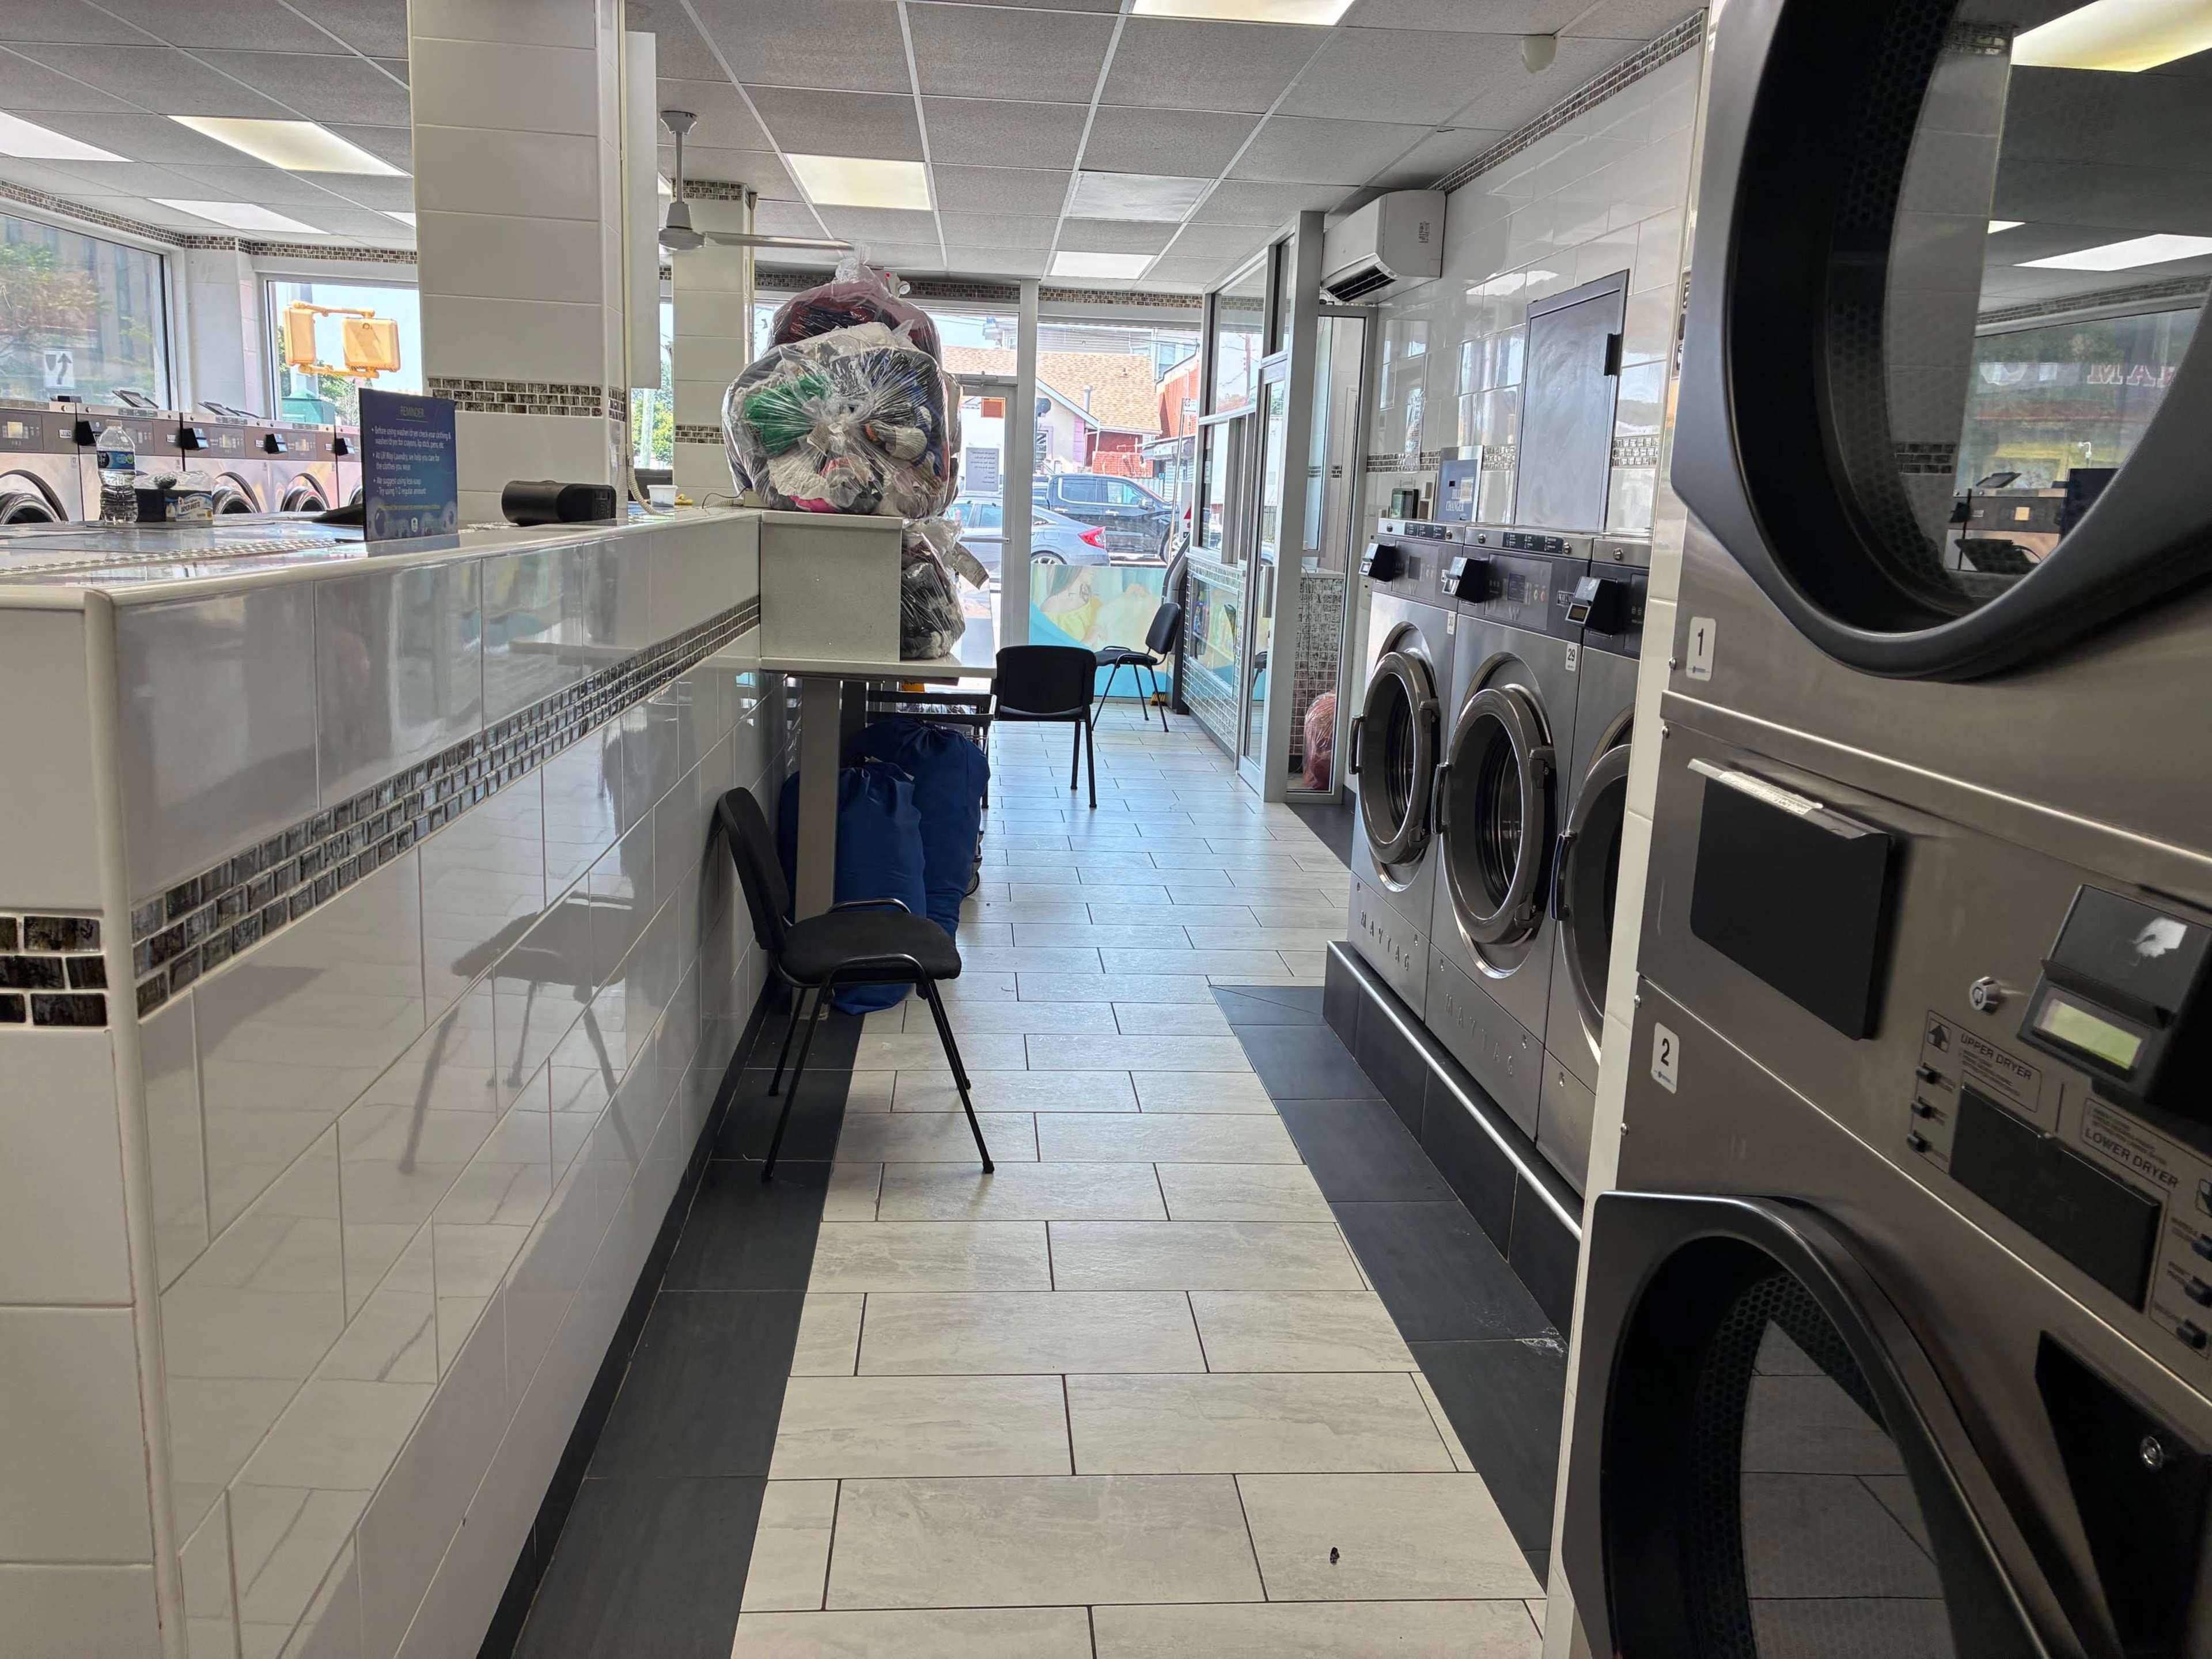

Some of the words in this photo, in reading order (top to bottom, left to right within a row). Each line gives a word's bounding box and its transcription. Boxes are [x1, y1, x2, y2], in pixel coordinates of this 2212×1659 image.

[1567, 649, 1575, 662] 29
[1698, 628, 1704, 656] 1
[1360, 910, 1410, 972] MAYTAG
[1661, 1037, 1670, 1067] 2
[1960, 1033, 1994, 1059] UPPER
[1995, 1054, 2032, 1081] DRYER
[2085, 1127, 2131, 1161] LOWER
[2133, 1155, 2179, 1188] DRYER
